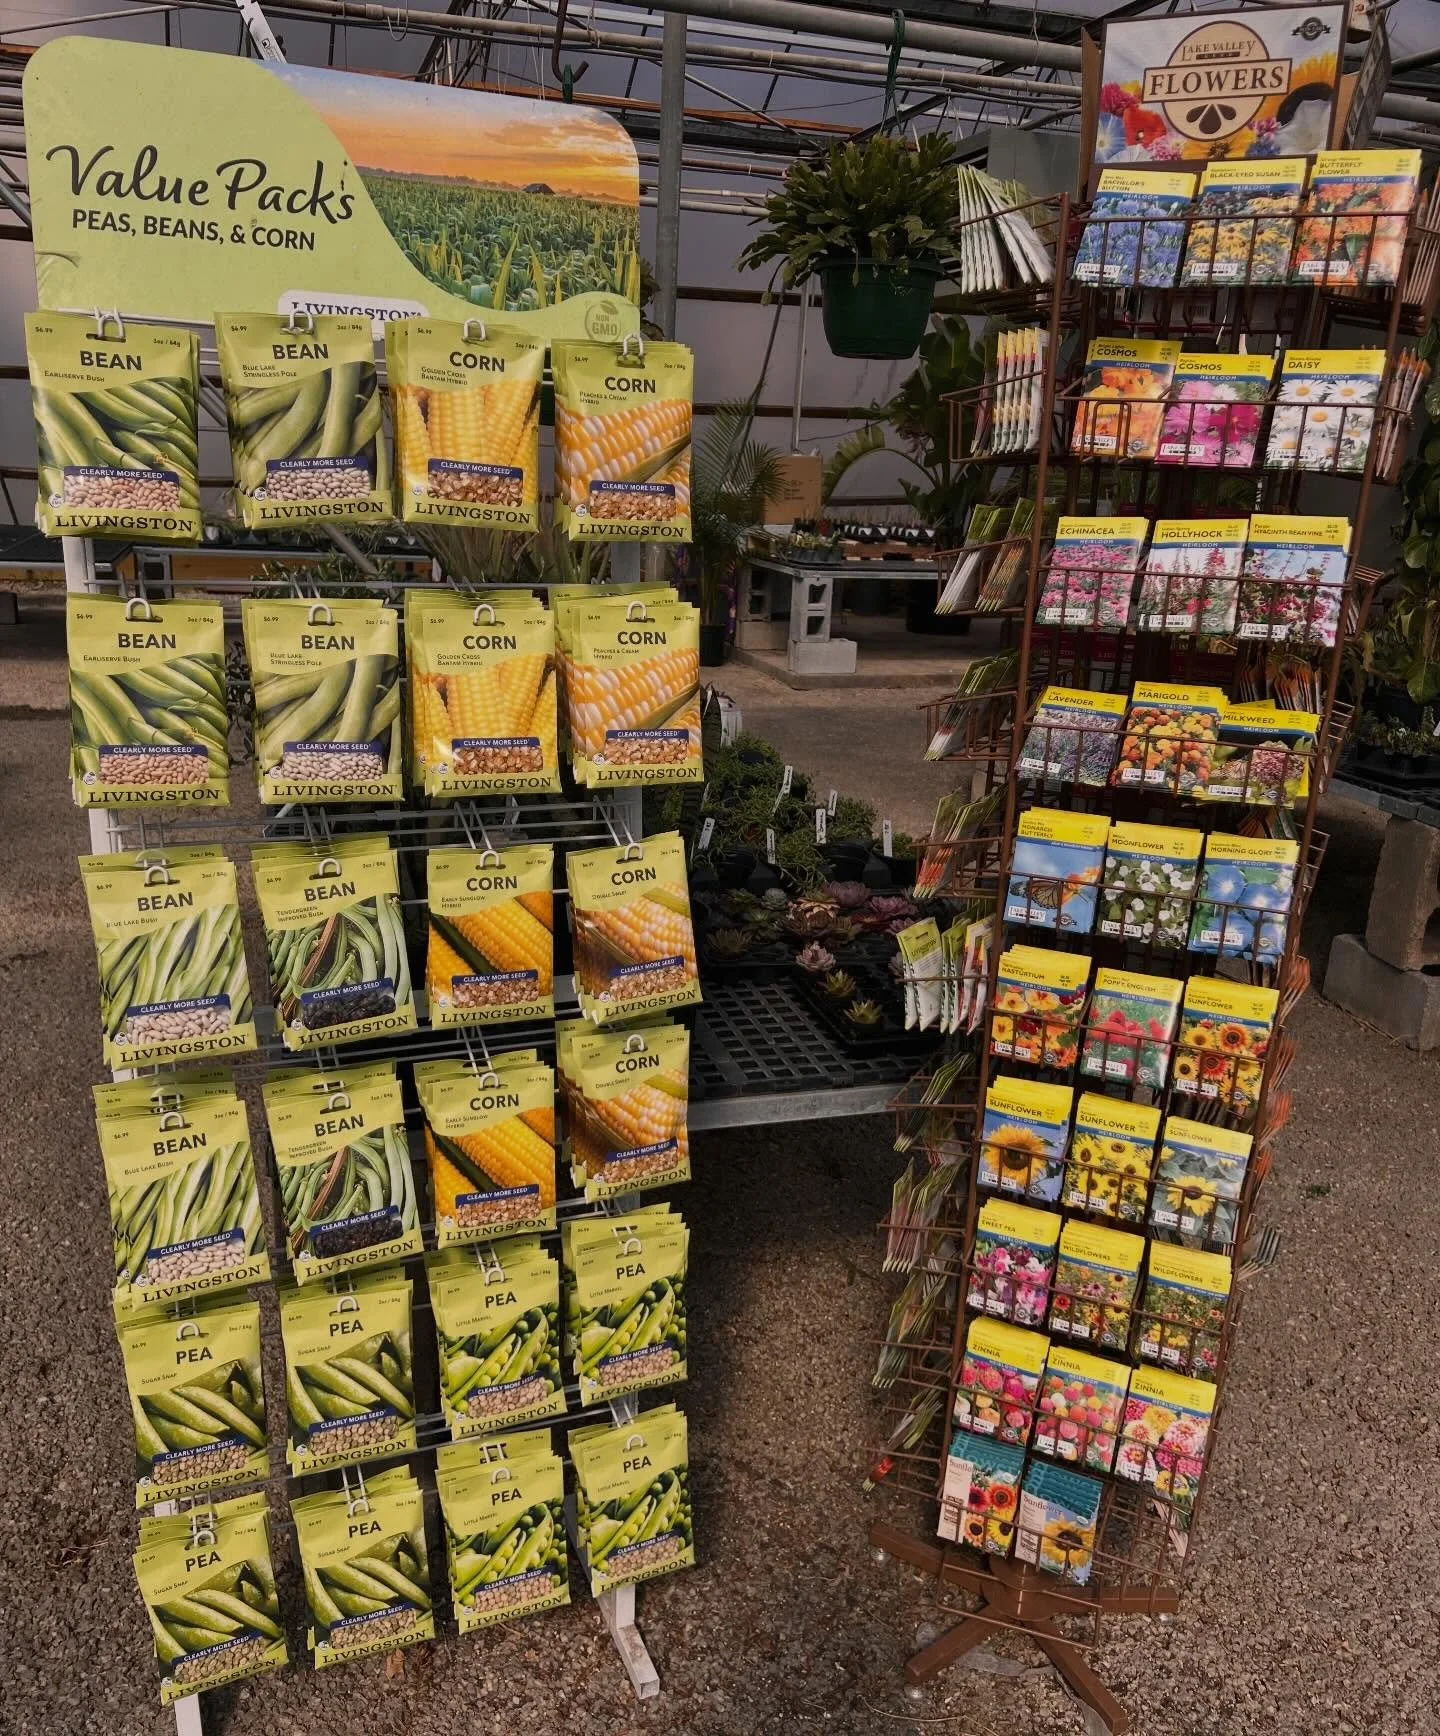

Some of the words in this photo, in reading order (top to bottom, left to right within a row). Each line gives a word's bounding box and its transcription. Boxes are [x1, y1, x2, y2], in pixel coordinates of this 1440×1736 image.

[1182, 44, 1212, 62] LAKE
[1214, 40, 1257, 57] VALLEY
[1149, 66, 1284, 96] FLOWERS
[46, 145, 208, 207] Value
[72, 208, 137, 235] PEAS,
[143, 216, 223, 244] BEANS,
[230, 224, 246, 244] &
[252, 225, 316, 251] CORN
[592, 322, 617, 336] GMO
[80, 351, 142, 371] BEAN
[272, 344, 328, 361] BEAN
[1097, 349, 1137, 357] COSMOS
[450, 351, 505, 373] CORN
[1179, 362, 1222, 371] COSMOS
[1288, 361, 1320, 369] DAISY
[605, 376, 656, 394] CORN
[280, 460, 314, 469] CLEARLY
[315, 459, 336, 467] MORE
[336, 458, 354, 467] SEED
[440, 461, 471, 471] CLEARLY
[471, 464, 491, 473] MORE
[80, 468, 114, 478] CLEARLY
[116, 470, 138, 480] MORE
[139, 472, 163, 481] SEED
[601, 482, 627, 491] CLEARLY
[647, 484, 664, 492] SEED
[260, 502, 383, 519] LIVINGSTON
[415, 502, 531, 525] LIVINGSTON
[56, 516, 192, 533] LIVINGSTON
[579, 523, 684, 539] LIVINGSTON
[1060, 527, 1115, 536] ECHINACEA
[1161, 530, 1222, 539] HOLLYHOCK
[118, 633, 176, 650] BEAN
[301, 634, 355, 651] BEAN
[463, 635, 517, 650] CORN
[617, 631, 667, 646] CORN
[1048, 695, 1095, 708] LAVENDER
[1138, 691, 1189, 702] MARIGOLD
[1223, 714, 1276, 725] MILKWEED
[113, 746, 147, 755] CLEARLY
[148, 746, 169, 754] MORE
[170, 746, 192, 754] SEED
[297, 743, 328, 751] CLEARLY
[350, 743, 370, 751] SEED
[597, 767, 698, 781] LIVINGSTON
[272, 784, 393, 797] LIVINGSTON
[441, 777, 552, 791] LIVINGSTON
[88, 789, 220, 803] LIVINGSTON
[1112, 838, 1165, 851] MOONFLOWER
[1211, 847, 1246, 855] MORNING
[467, 876, 517, 892] CORN
[611, 867, 656, 887] CORN
[304, 882, 356, 903] BEAN
[137, 891, 193, 913] BEAN
[463, 976, 490, 984] CLEARLY
[491, 974, 509, 982] MORE
[140, 1002, 174, 1014] CLEARLY
[175, 1000, 194, 1010] MORE
[195, 998, 215, 1007] SEED
[605, 990, 696, 1017] LIVINGSTON
[1188, 998, 1233, 1011] SUNFLOWER
[440, 1006, 547, 1024] LIVINGSTON
[299, 1015, 408, 1046] LIVINGSTON
[120, 1034, 247, 1064] LIVINGSTON
[615, 1054, 660, 1074] CORN
[470, 1094, 519, 1111] CORN
[989, 1100, 1042, 1117] SUNFLOWER
[315, 1114, 365, 1138] BEAN
[1080, 1114, 1136, 1132] SUNFLOWER
[153, 1133, 207, 1157] BEAN
[1169, 1129, 1213, 1143] SUNFLOWER
[598, 1168, 687, 1197] LIVINGSTON
[446, 1218, 548, 1242] LIVINGSTON
[160, 1242, 191, 1256] CLEARLY
[191, 1238, 212, 1249] MORE
[213, 1233, 232, 1244] SEED
[305, 1240, 415, 1278] LIVINGSTON
[616, 1263, 645, 1280] PEA
[1154, 1265, 1204, 1284] WILDFLOWERS
[143, 1264, 261, 1304] LIVINGSTON
[485, 1291, 517, 1309] PEA
[329, 1319, 364, 1337] PEA
[176, 1346, 213, 1365] PEA
[972, 1343, 1001, 1358] ZINNIA
[1052, 1357, 1080, 1372] ZINNIA
[590, 1372, 681, 1402] LIVINGSTON
[1135, 1381, 1164, 1397] ZINNIA
[320, 1419, 347, 1430] CLEARLY
[348, 1415, 367, 1425] MORE
[368, 1410, 385, 1420] SEED
[460, 1402, 558, 1435] LIVINGSTON
[301, 1440, 408, 1471] LIVINGSTON
[623, 1456, 651, 1474] PEA
[144, 1469, 258, 1503] LIVINGSTON
[491, 1488, 522, 1506] PEA
[1023, 1494, 1064, 1516] Sunflower
[348, 1520, 382, 1539] PEA
[185, 1551, 222, 1572] PEA
[484, 1580, 509, 1590] CLEARLY
[509, 1575, 528, 1585] MORE
[601, 1556, 688, 1592] LIVINGSTON
[467, 1596, 562, 1629] LIVINGSTON
[323, 1629, 427, 1665] LIVINGSTON
[168, 1658, 276, 1701] LIVINGSTON
